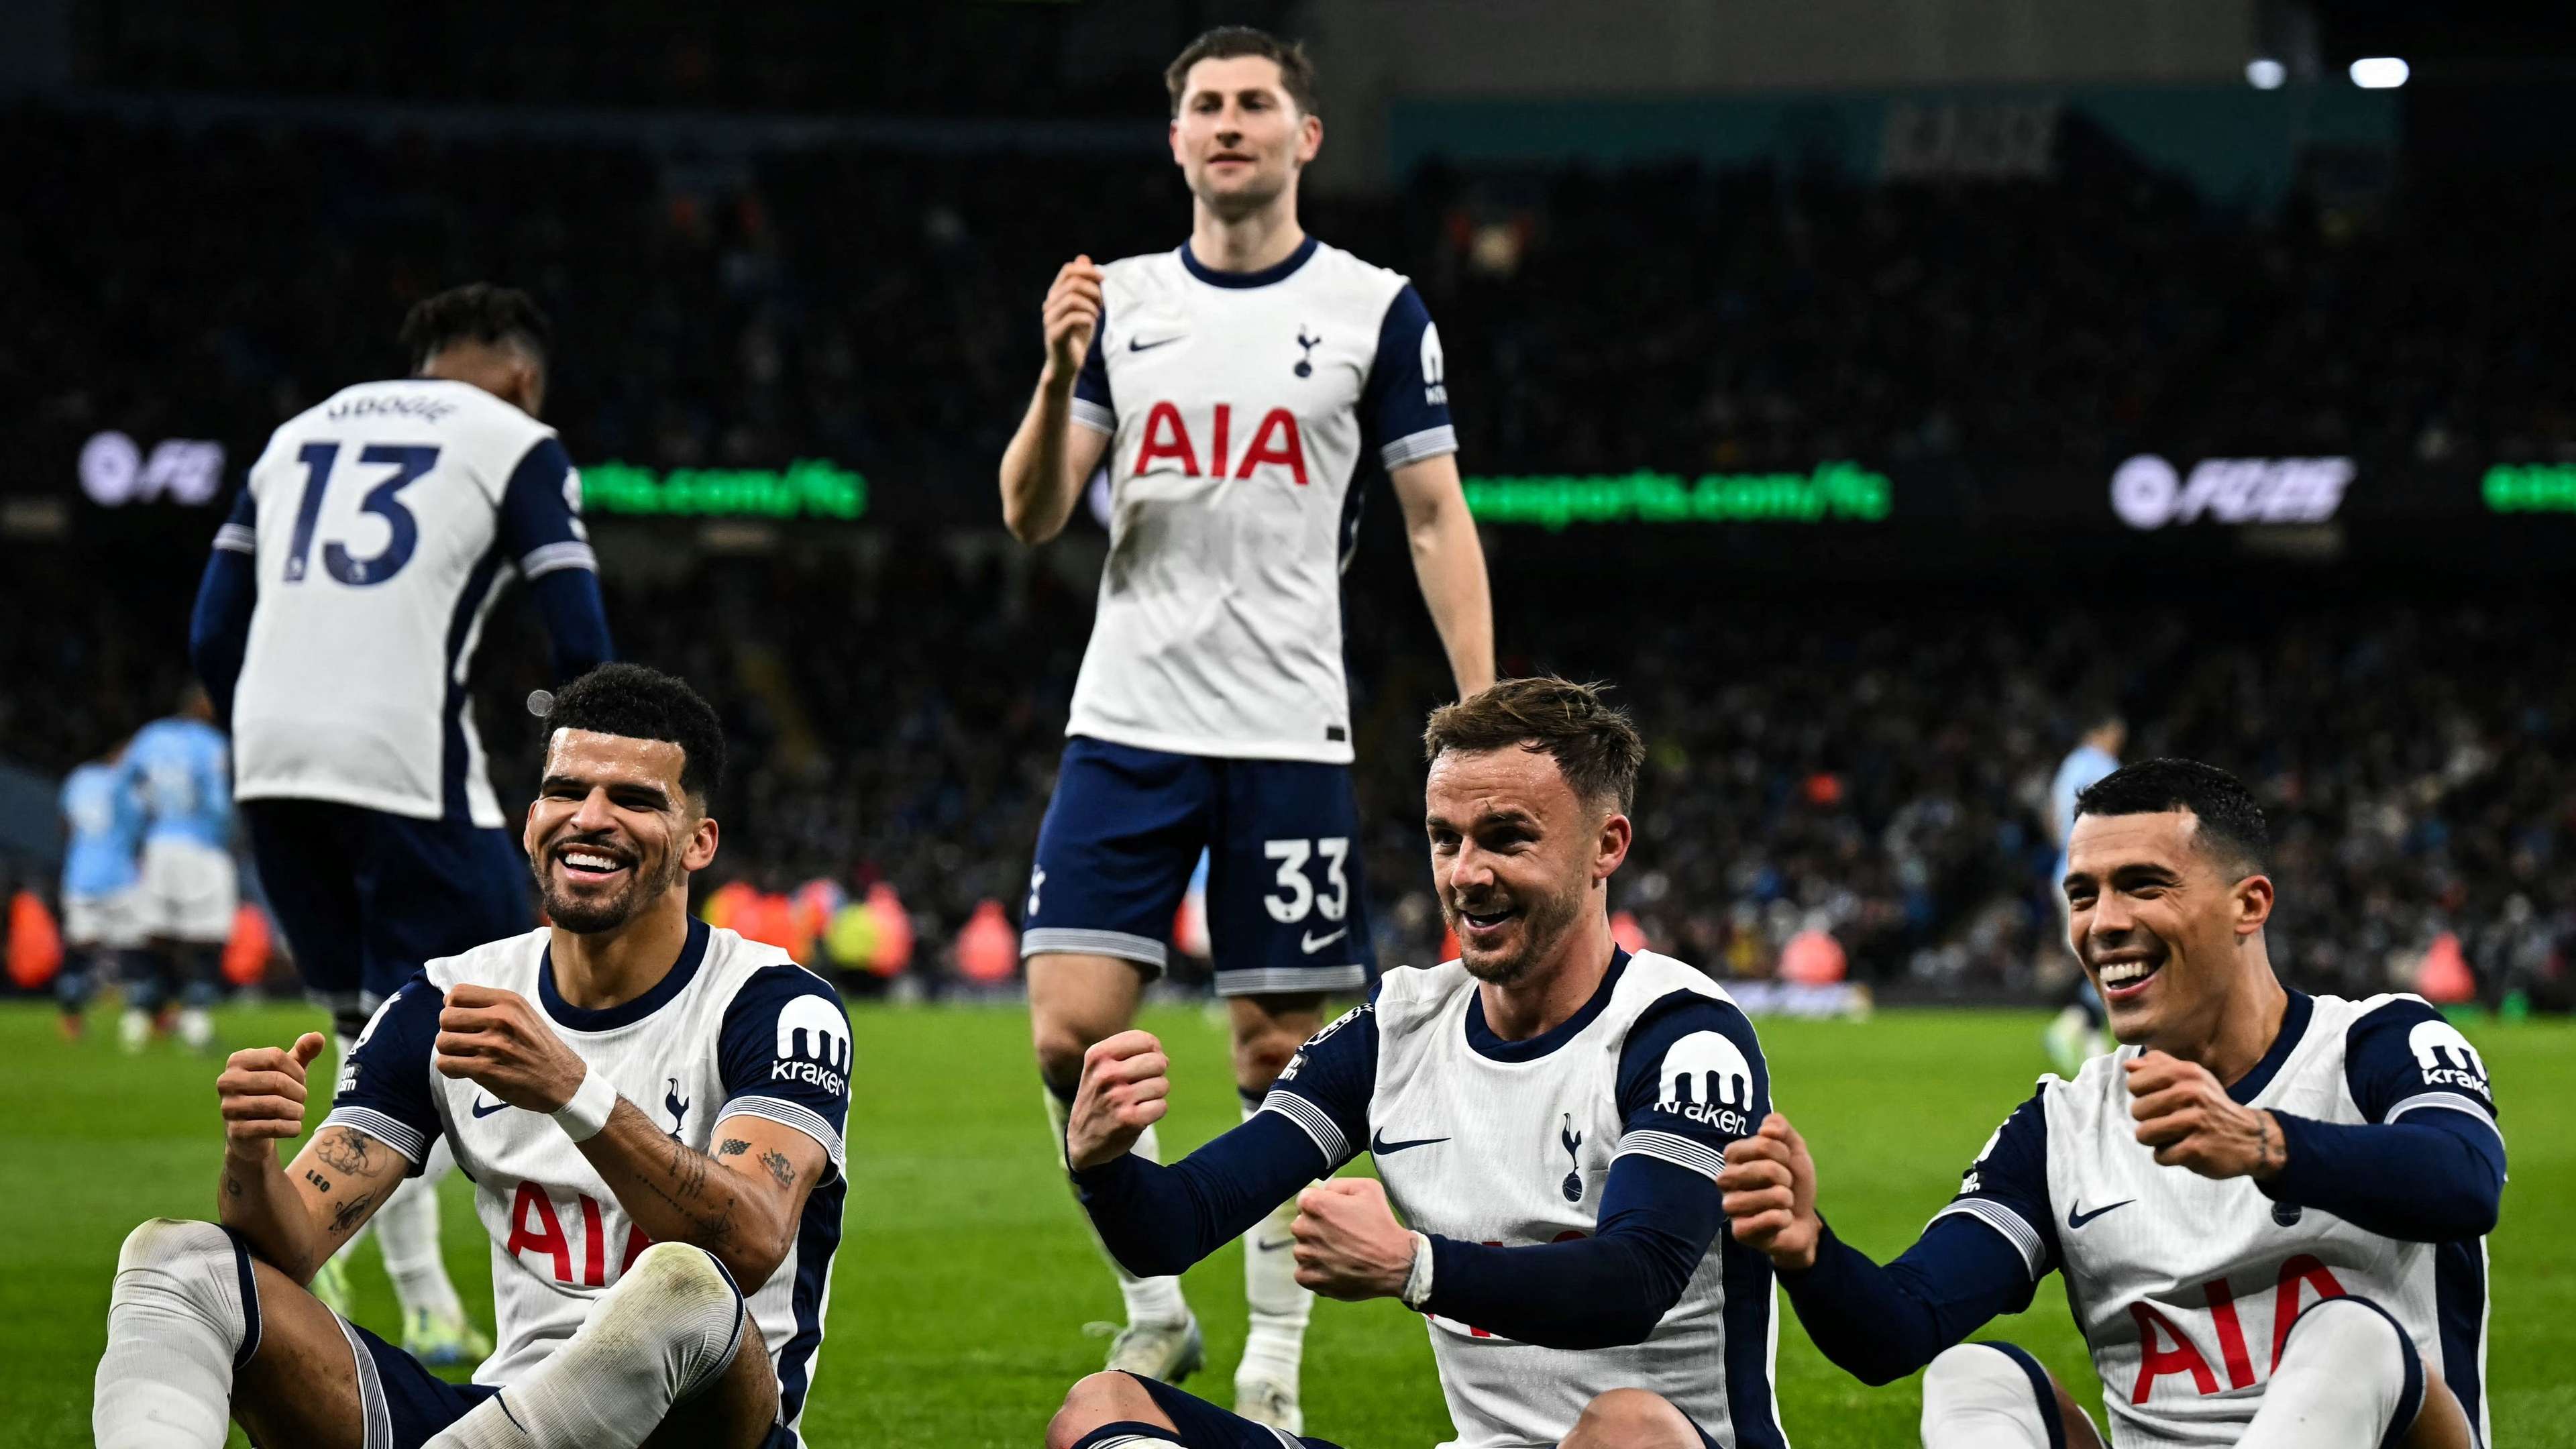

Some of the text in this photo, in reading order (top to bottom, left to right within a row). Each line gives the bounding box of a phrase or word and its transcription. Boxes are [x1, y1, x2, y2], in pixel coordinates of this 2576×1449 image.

[1134, 400, 1309, 486] AIA
[282, 442, 442, 584] 13
[1264, 837, 1349, 924] 33
[771, 1060, 845, 1096] kraken
[305, 1169, 331, 1193] LEO
[507, 1180, 655, 1287] AI
